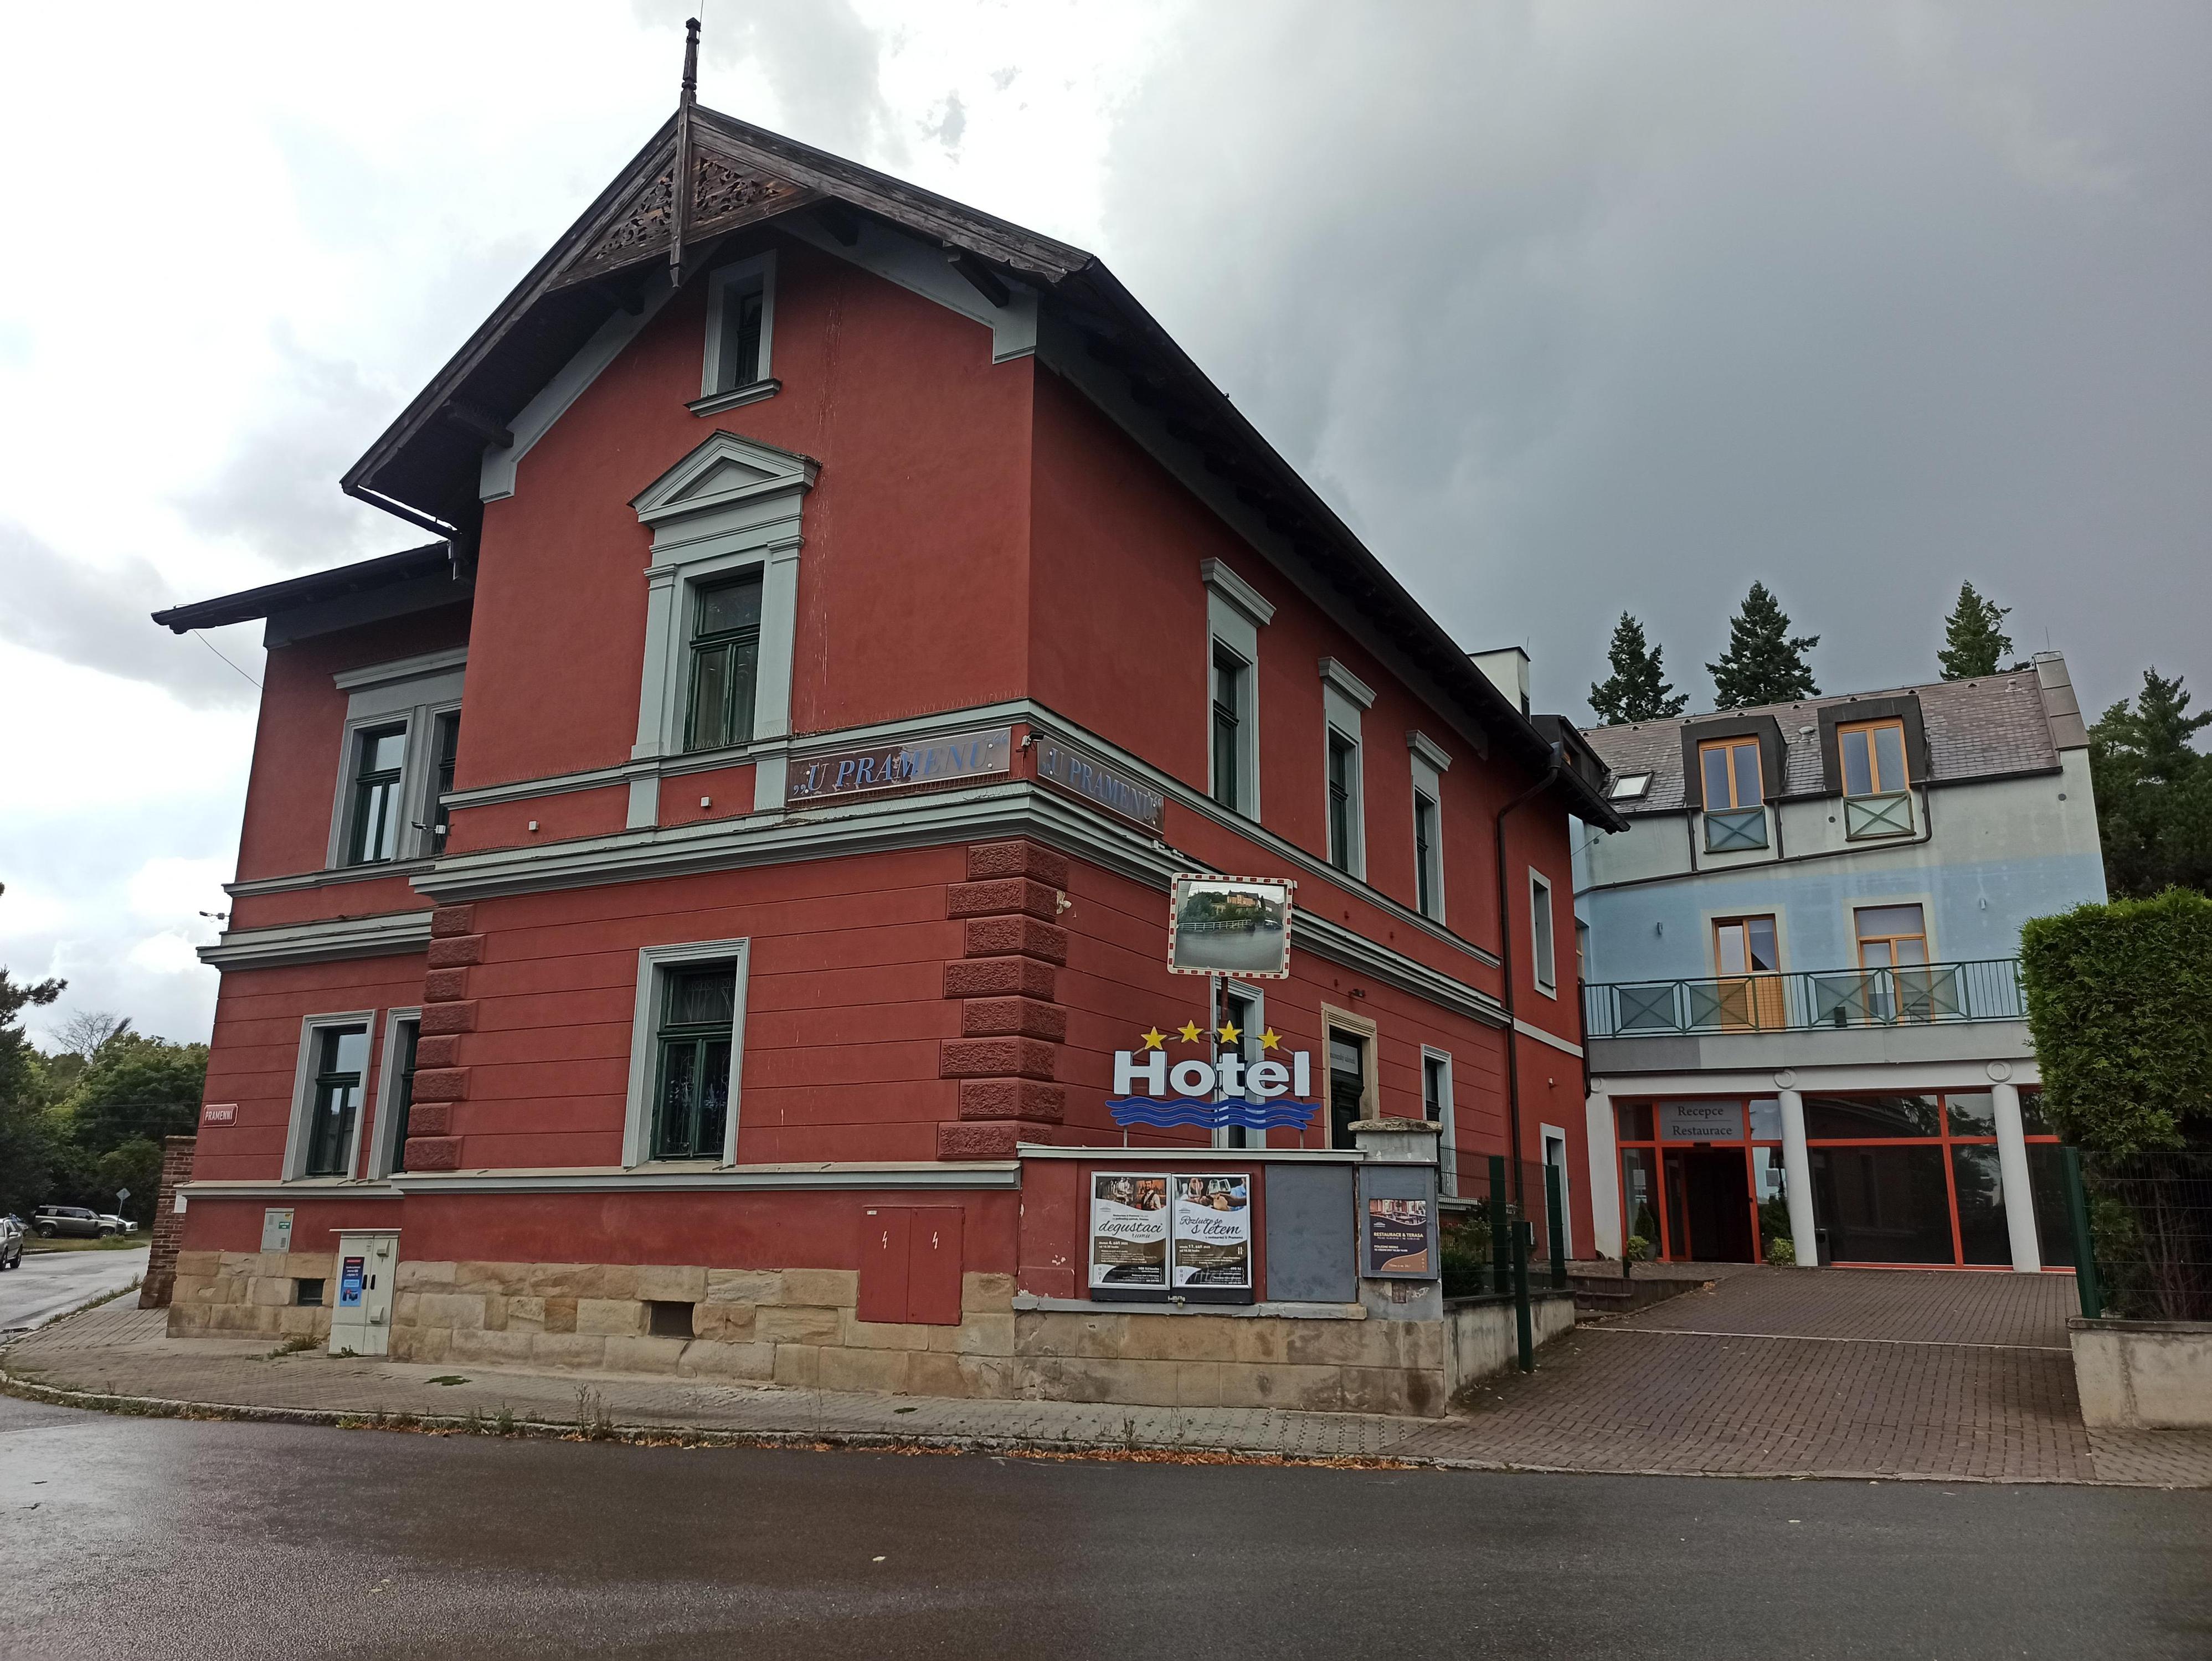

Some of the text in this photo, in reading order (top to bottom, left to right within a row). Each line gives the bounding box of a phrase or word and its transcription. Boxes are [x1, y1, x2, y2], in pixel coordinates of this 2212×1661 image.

[1113, 1050, 1310, 1097] Hotel
[204, 1108, 234, 1121] PRAMENNÍ
[1678, 1106, 1724, 1119] Recepce
[1672, 1126, 1733, 1136] Restaurace
[1098, 1220, 1163, 1236] degustaci
[1191, 1224, 1201, 1234] s
